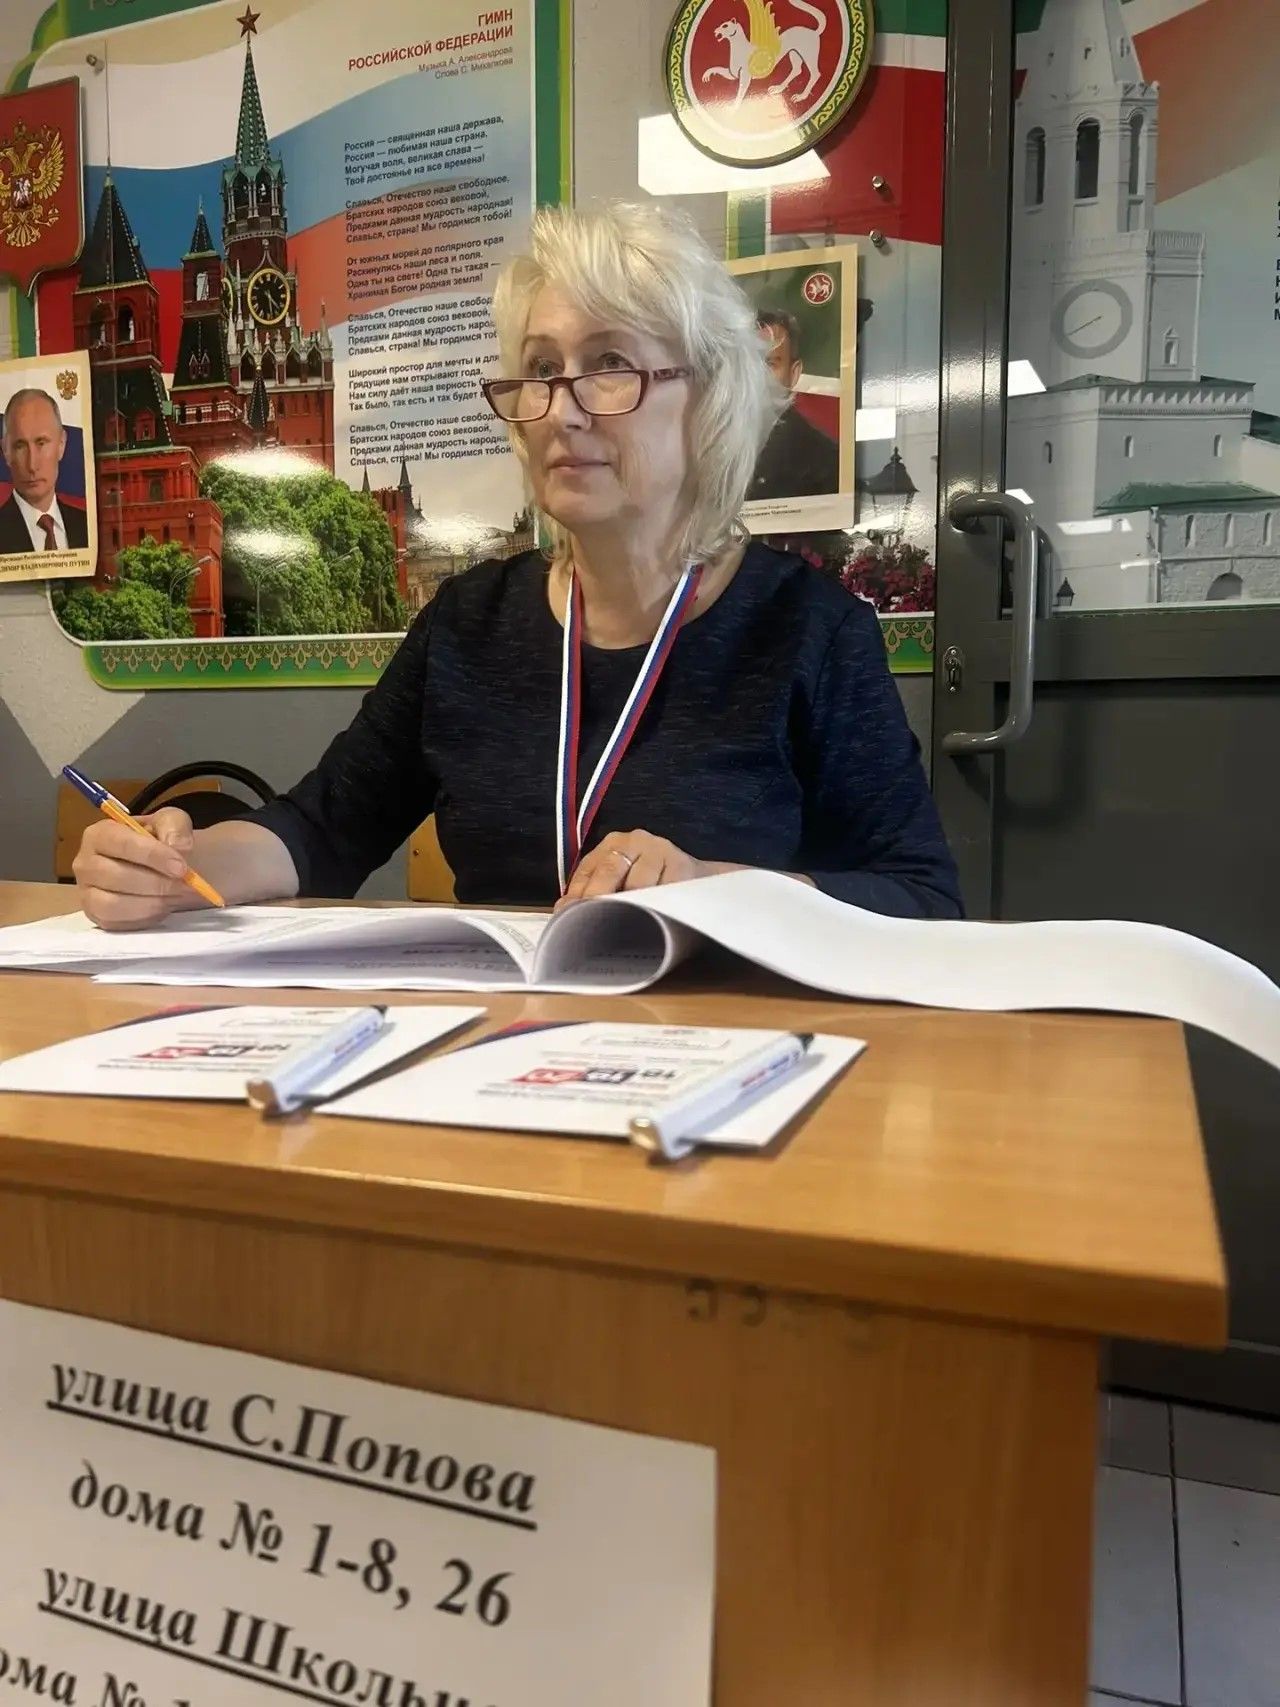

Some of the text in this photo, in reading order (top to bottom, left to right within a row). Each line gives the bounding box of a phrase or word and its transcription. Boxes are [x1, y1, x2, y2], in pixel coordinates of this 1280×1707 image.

[478, 8, 513, 26] ГИМН
[349, 25, 513, 70] РОССИЙСКОЙ ФЕДЕРАЦИИ
[345, 141, 374, 151] Россия
[387, 129, 435, 144] священная
[438, 124, 460, 134] наша
[463, 115, 503, 130] держава,
[345, 152, 374, 163] Россия
[388, 140, 427, 155] любимая
[430, 136, 452, 146] наша
[345, 161, 380, 174] Могучая
[408, 150, 443, 163] великая
[445, 145, 471, 156] слава
[414, 165, 424, 173] на
[445, 154, 485, 168] времена!
[387, 189, 431, 202] Отечество
[434, 185, 456, 194] наше
[346, 209, 384, 221] Братских
[387, 201, 423, 214] народов
[426, 198, 448, 206] союз
[346, 197, 512, 232] Предками данная мудрость народная!
[346, 209, 512, 243] Славься, страна! Мы гордимся тобой!
[347, 236, 503, 266] От южных морей до полярного края
[347, 264, 401, 277] Раскинулись
[404, 260, 426, 269] наши
[429, 257, 448, 265] леса
[459, 252, 483, 261] поля.
[347, 280, 369, 289] Одна
[397, 270, 423, 282] свете!
[426, 268, 448, 278] Одна
[465, 262, 488, 271] такая
[348, 273, 483, 300] Хранимая Богом родная земля!
[349, 296, 493, 322] Славься, Отечество наше свобод
[349, 309, 490, 334] Братских народов союз вековой,
[349, 333, 389, 345] Предками
[392, 329, 422, 340] данная
[425, 324, 466, 337] мудрость
[349, 345, 386, 356] Славься,
[389, 340, 420, 353] страна!
[423, 338, 437, 346] Мы
[440, 332, 481, 344] гордимся
[349, 367, 387, 378] Широкий
[389, 362, 424, 375] простор
[426, 361, 442, 369] для
[445, 358, 472, 368] мечты
[349, 379, 390, 390] Грядущие
[411, 370, 458, 382] открывают
[461, 367, 483, 376] года.
[349, 391, 366, 400] Нам
[368, 388, 387, 398] силу
[412, 384, 433, 393] наша
[436, 380, 476, 392] верность
[349, 401, 363, 411] Так
[365, 398, 390, 409] было,
[393, 398, 406, 407] так
[408, 396, 427, 404] есть
[453, 391, 477, 401] будет
[350, 412, 499, 433] Славься, Отечество наше свободн
[350, 424, 492, 444] Братских народов союз вековой,
[350, 445, 391, 455] Предками
[393, 441, 423, 452] данная
[426, 439, 467, 449] мудрость
[350, 456, 388, 466] Славься,
[391, 451, 422, 464] страна!
[425, 451, 439, 460] Мы
[442, 448, 483, 459] гордимся
[51, 1361, 536, 1514] улица С.Попова
[71, 1458, 513, 1628] дома № 1-8, 26
[44, 1567, 496, 1707] улица Школь
